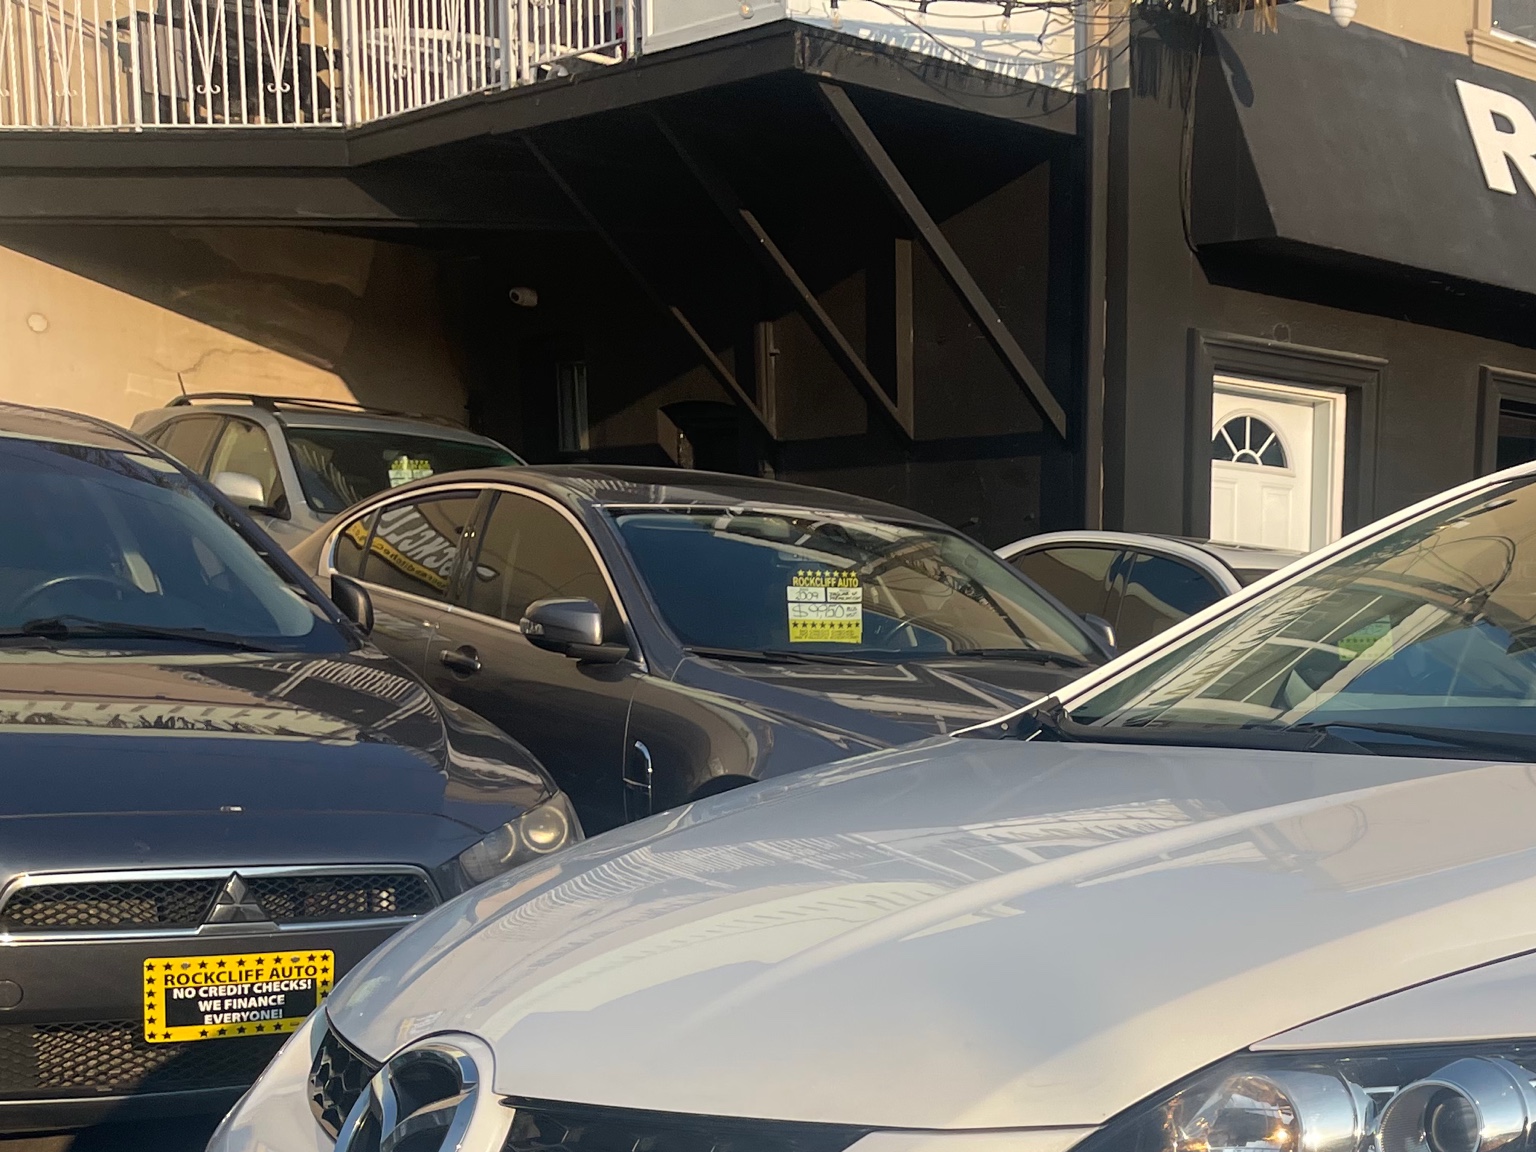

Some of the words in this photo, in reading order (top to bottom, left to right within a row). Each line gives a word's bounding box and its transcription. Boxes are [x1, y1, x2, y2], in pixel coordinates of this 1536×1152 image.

[792, 576, 837, 587] ROCKCLIFF
[837, 577, 859, 587] AUTO
[164, 968, 264, 986] ROCKCLIFF
[269, 965, 318, 980] AUTO
[172, 987, 196, 999] NO
[199, 984, 251, 998] CREDIT
[252, 979, 312, 994] CHECKS!
[198, 1000, 223, 1012] WE
[224, 994, 285, 1010] FINANCE
[204, 1008, 283, 1025] EVERYONE!
